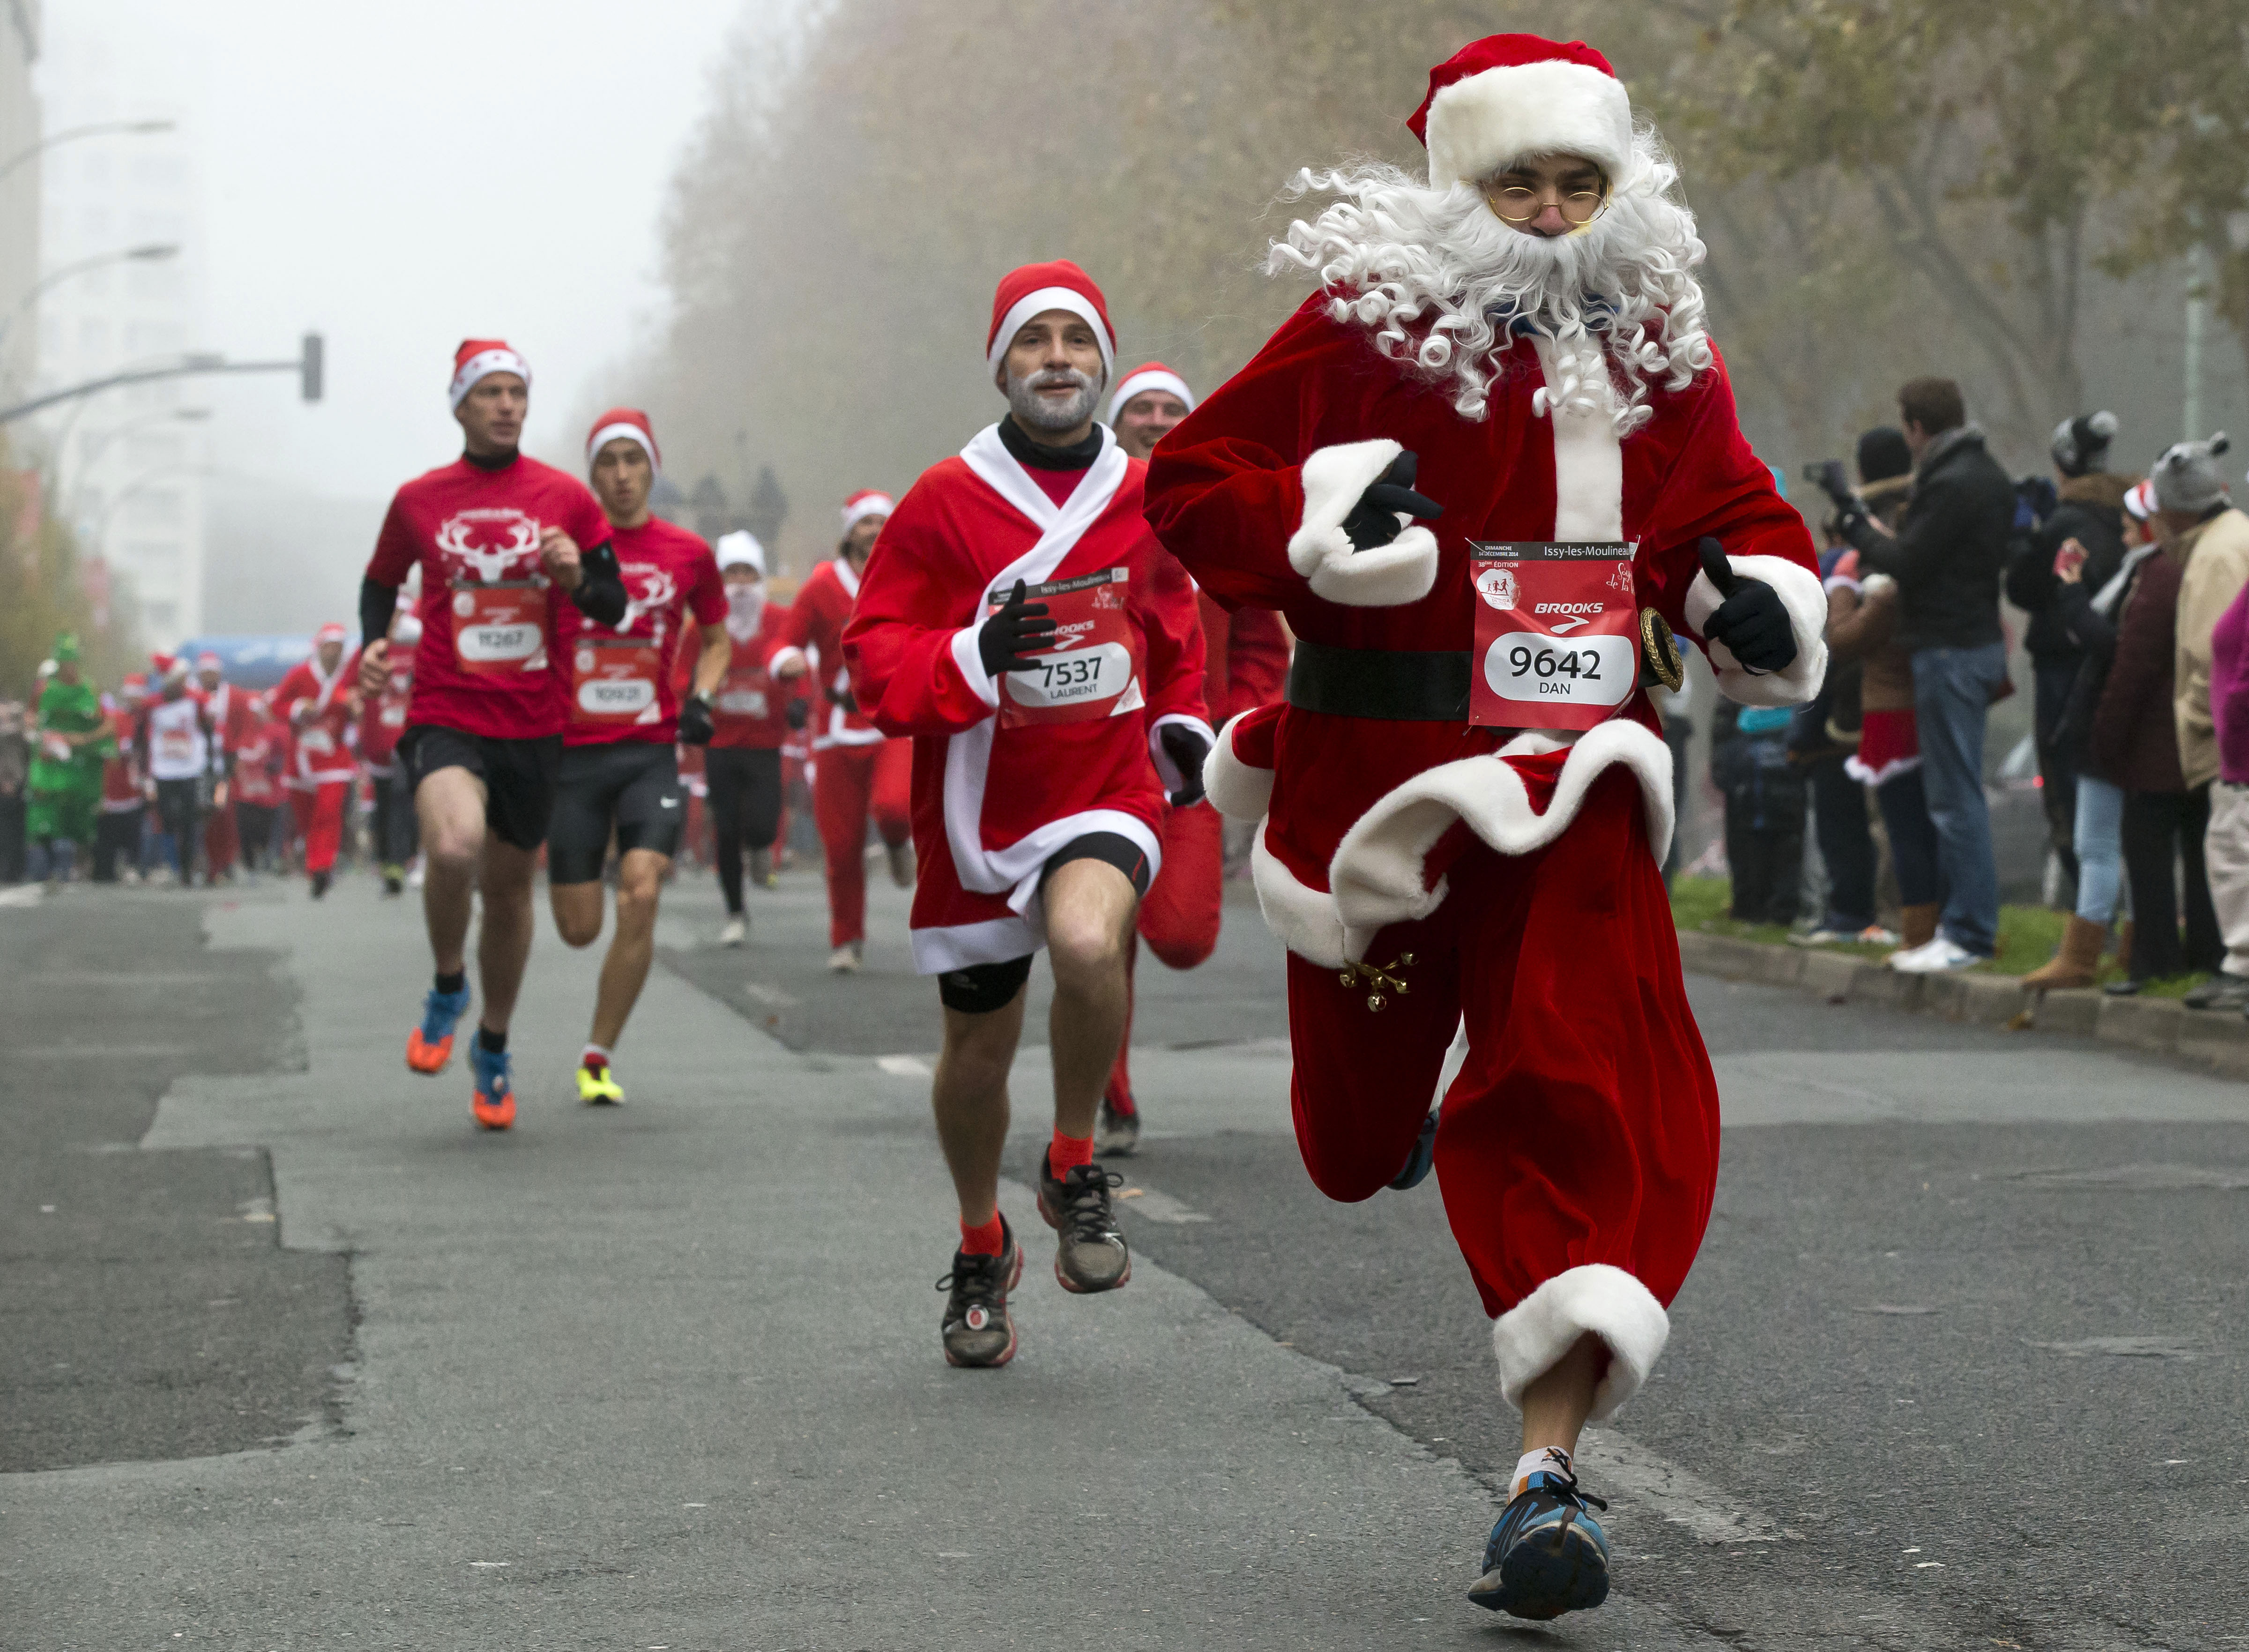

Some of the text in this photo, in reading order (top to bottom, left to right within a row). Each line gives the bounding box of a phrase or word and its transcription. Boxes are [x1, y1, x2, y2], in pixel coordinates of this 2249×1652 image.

[1544, 545, 1630, 558] Issy-les-Moulineau
[1534, 603, 1604, 614] BROOKS
[1509, 646, 1601, 680] 9642
[1039, 656, 1102, 688] 7537
[1050, 683, 1097, 699] LAURENT
[1539, 682, 1571, 694] DAN
